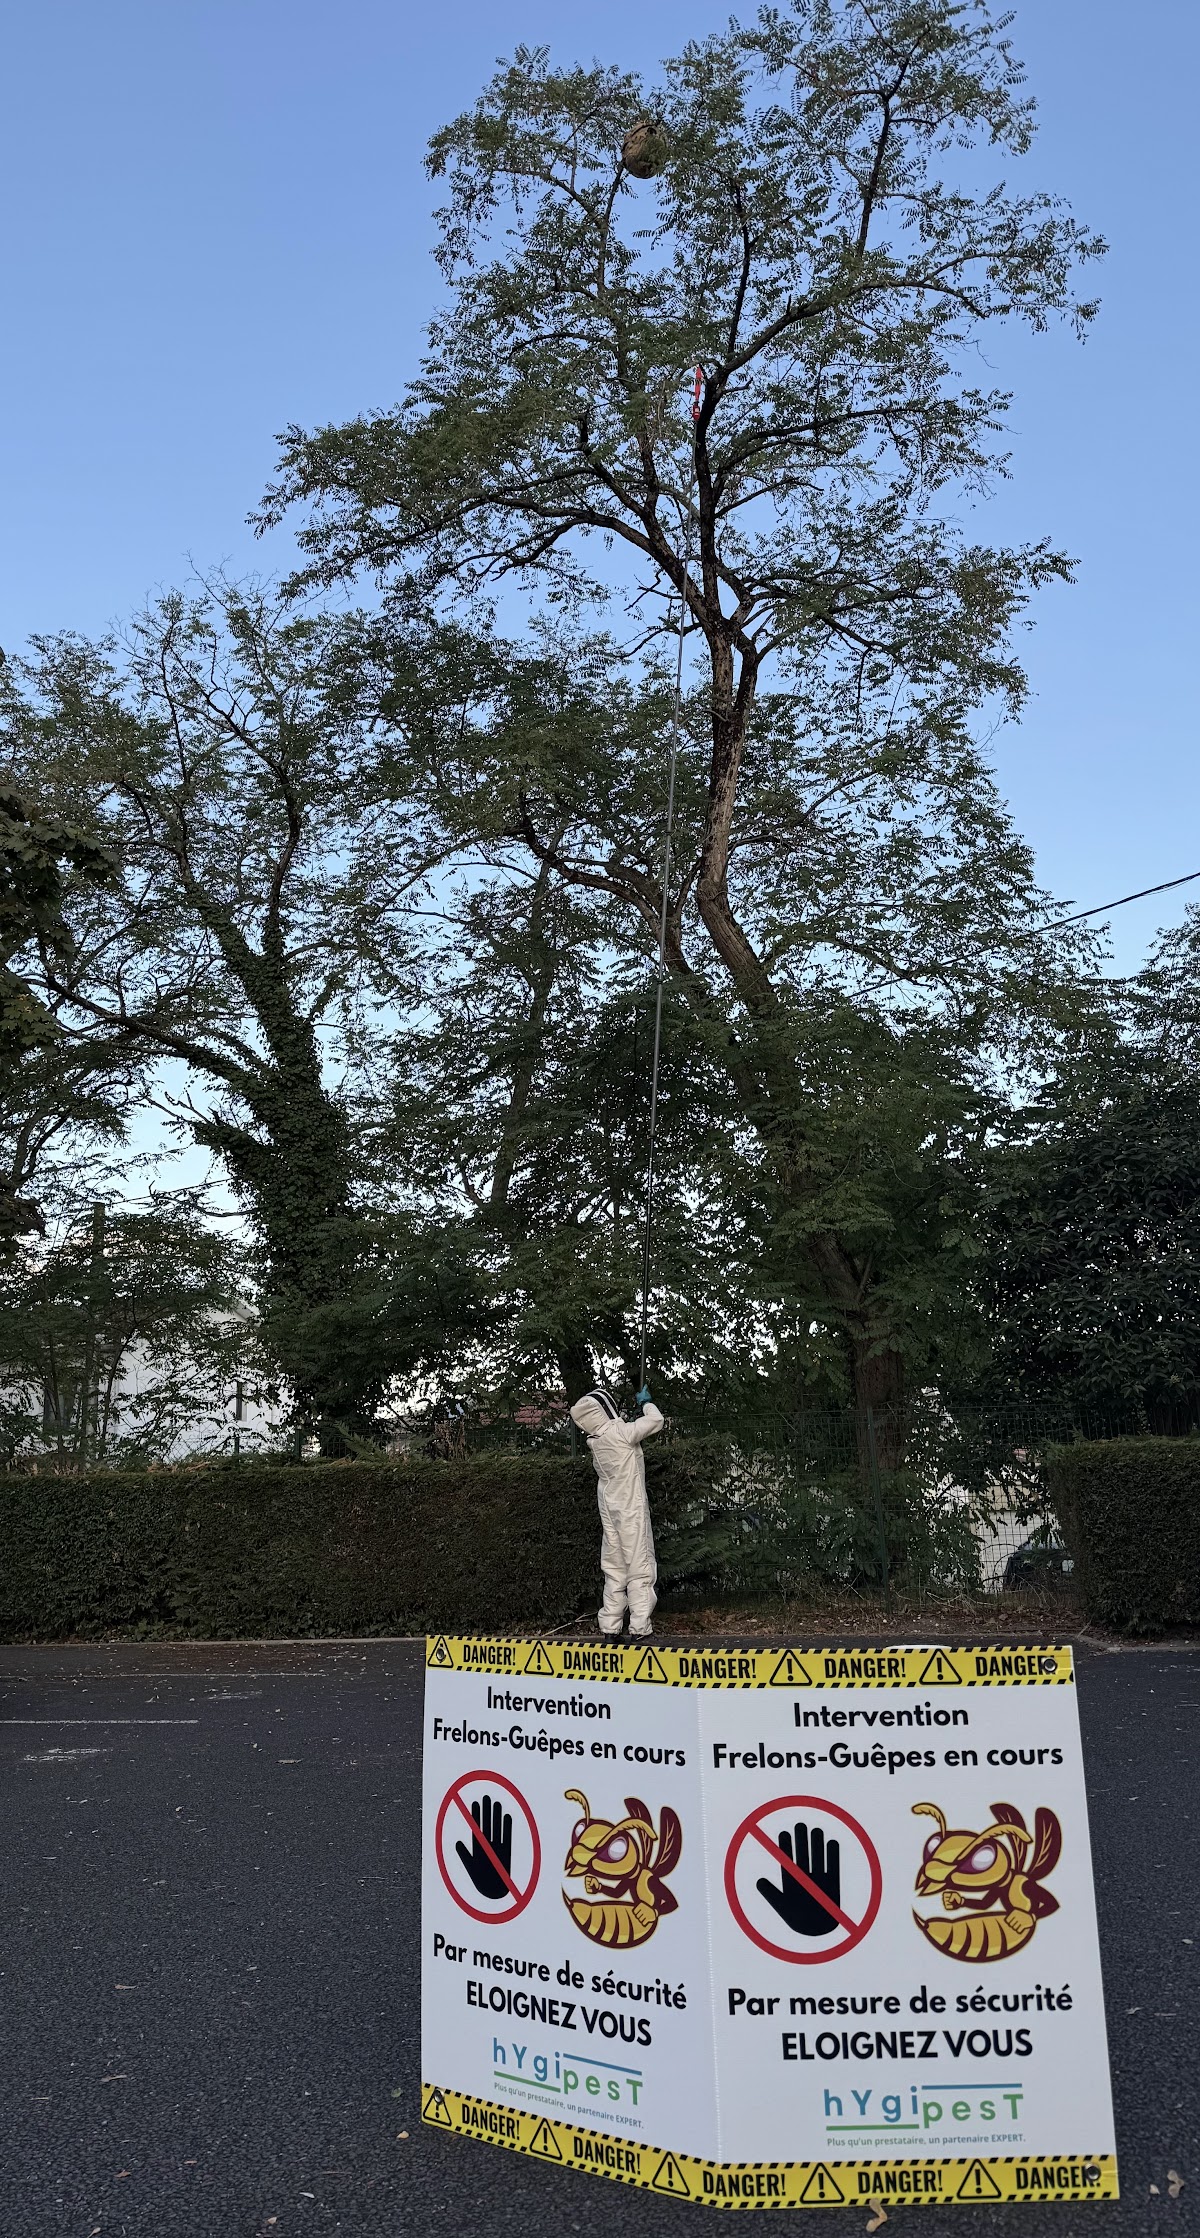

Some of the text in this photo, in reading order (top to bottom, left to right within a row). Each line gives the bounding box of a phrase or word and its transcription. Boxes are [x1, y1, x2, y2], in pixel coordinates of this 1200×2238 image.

[462, 1644, 516, 1666] DANGER!
[563, 1651, 624, 1673] DANGER!
[679, 1657, 757, 1679] DANGER!
[824, 1656, 906, 1679] DANGER!
[487, 1686, 611, 1719] Intervention
[794, 1702, 969, 1727] Intervention
[433, 1718, 686, 1767] Frelons-Guêpes en cours
[713, 1743, 1063, 1774] Frelons-Guêpes en cours
[433, 1933, 687, 2010] Par mesure de sécurité
[466, 1980, 652, 2046] ELOIGNEZ VOUS
[728, 1984, 1072, 2015] Par mesure de sécurité
[782, 2029, 1033, 2060] ELOIGNEZ VOUS
[494, 2082, 507, 2093] Plus
[508, 2088, 527, 2098] qu'un
[527, 2092, 566, 2110] prestataire,
[577, 2106, 614, 2121] partenaire
[615, 2114, 644, 2129] EXPERT.
[461, 2103, 1101, 2197] DANGER! DANGER! DANGER! DANGER! DANGER
[827, 2138, 846, 2146] Plus
[847, 2137, 873, 2147] qu'un
[874, 2136, 927, 2147] prestataire,
[942, 2135, 990, 2147] partenaire
[991, 2133, 1026, 2143] EXPERT.
